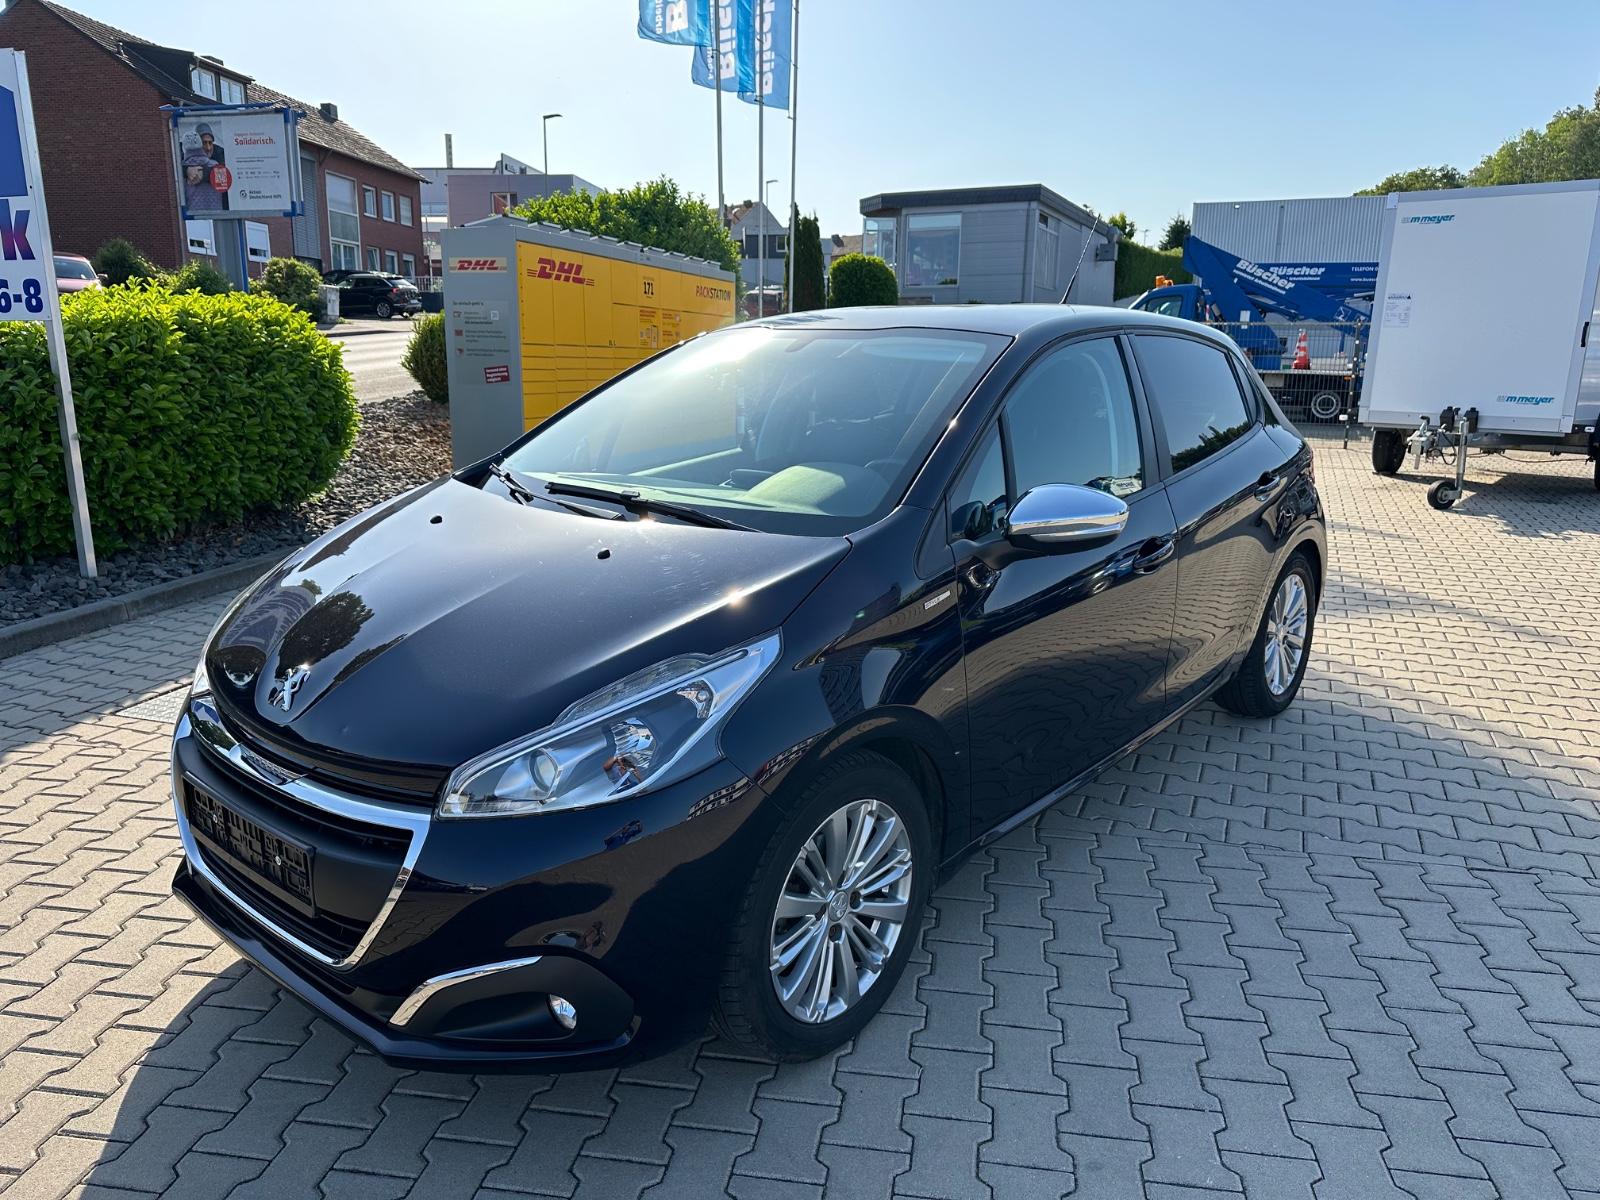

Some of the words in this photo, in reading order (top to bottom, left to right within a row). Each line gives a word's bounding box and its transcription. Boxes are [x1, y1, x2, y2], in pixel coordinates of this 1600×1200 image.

[456, 259, 499, 270] DHL
[536, 256, 586, 285] DHL
[1236, 259, 1296, 291] Büscher
[643, 281, 654, 296] 171
[695, 284, 732, 301] PACKSTATION
